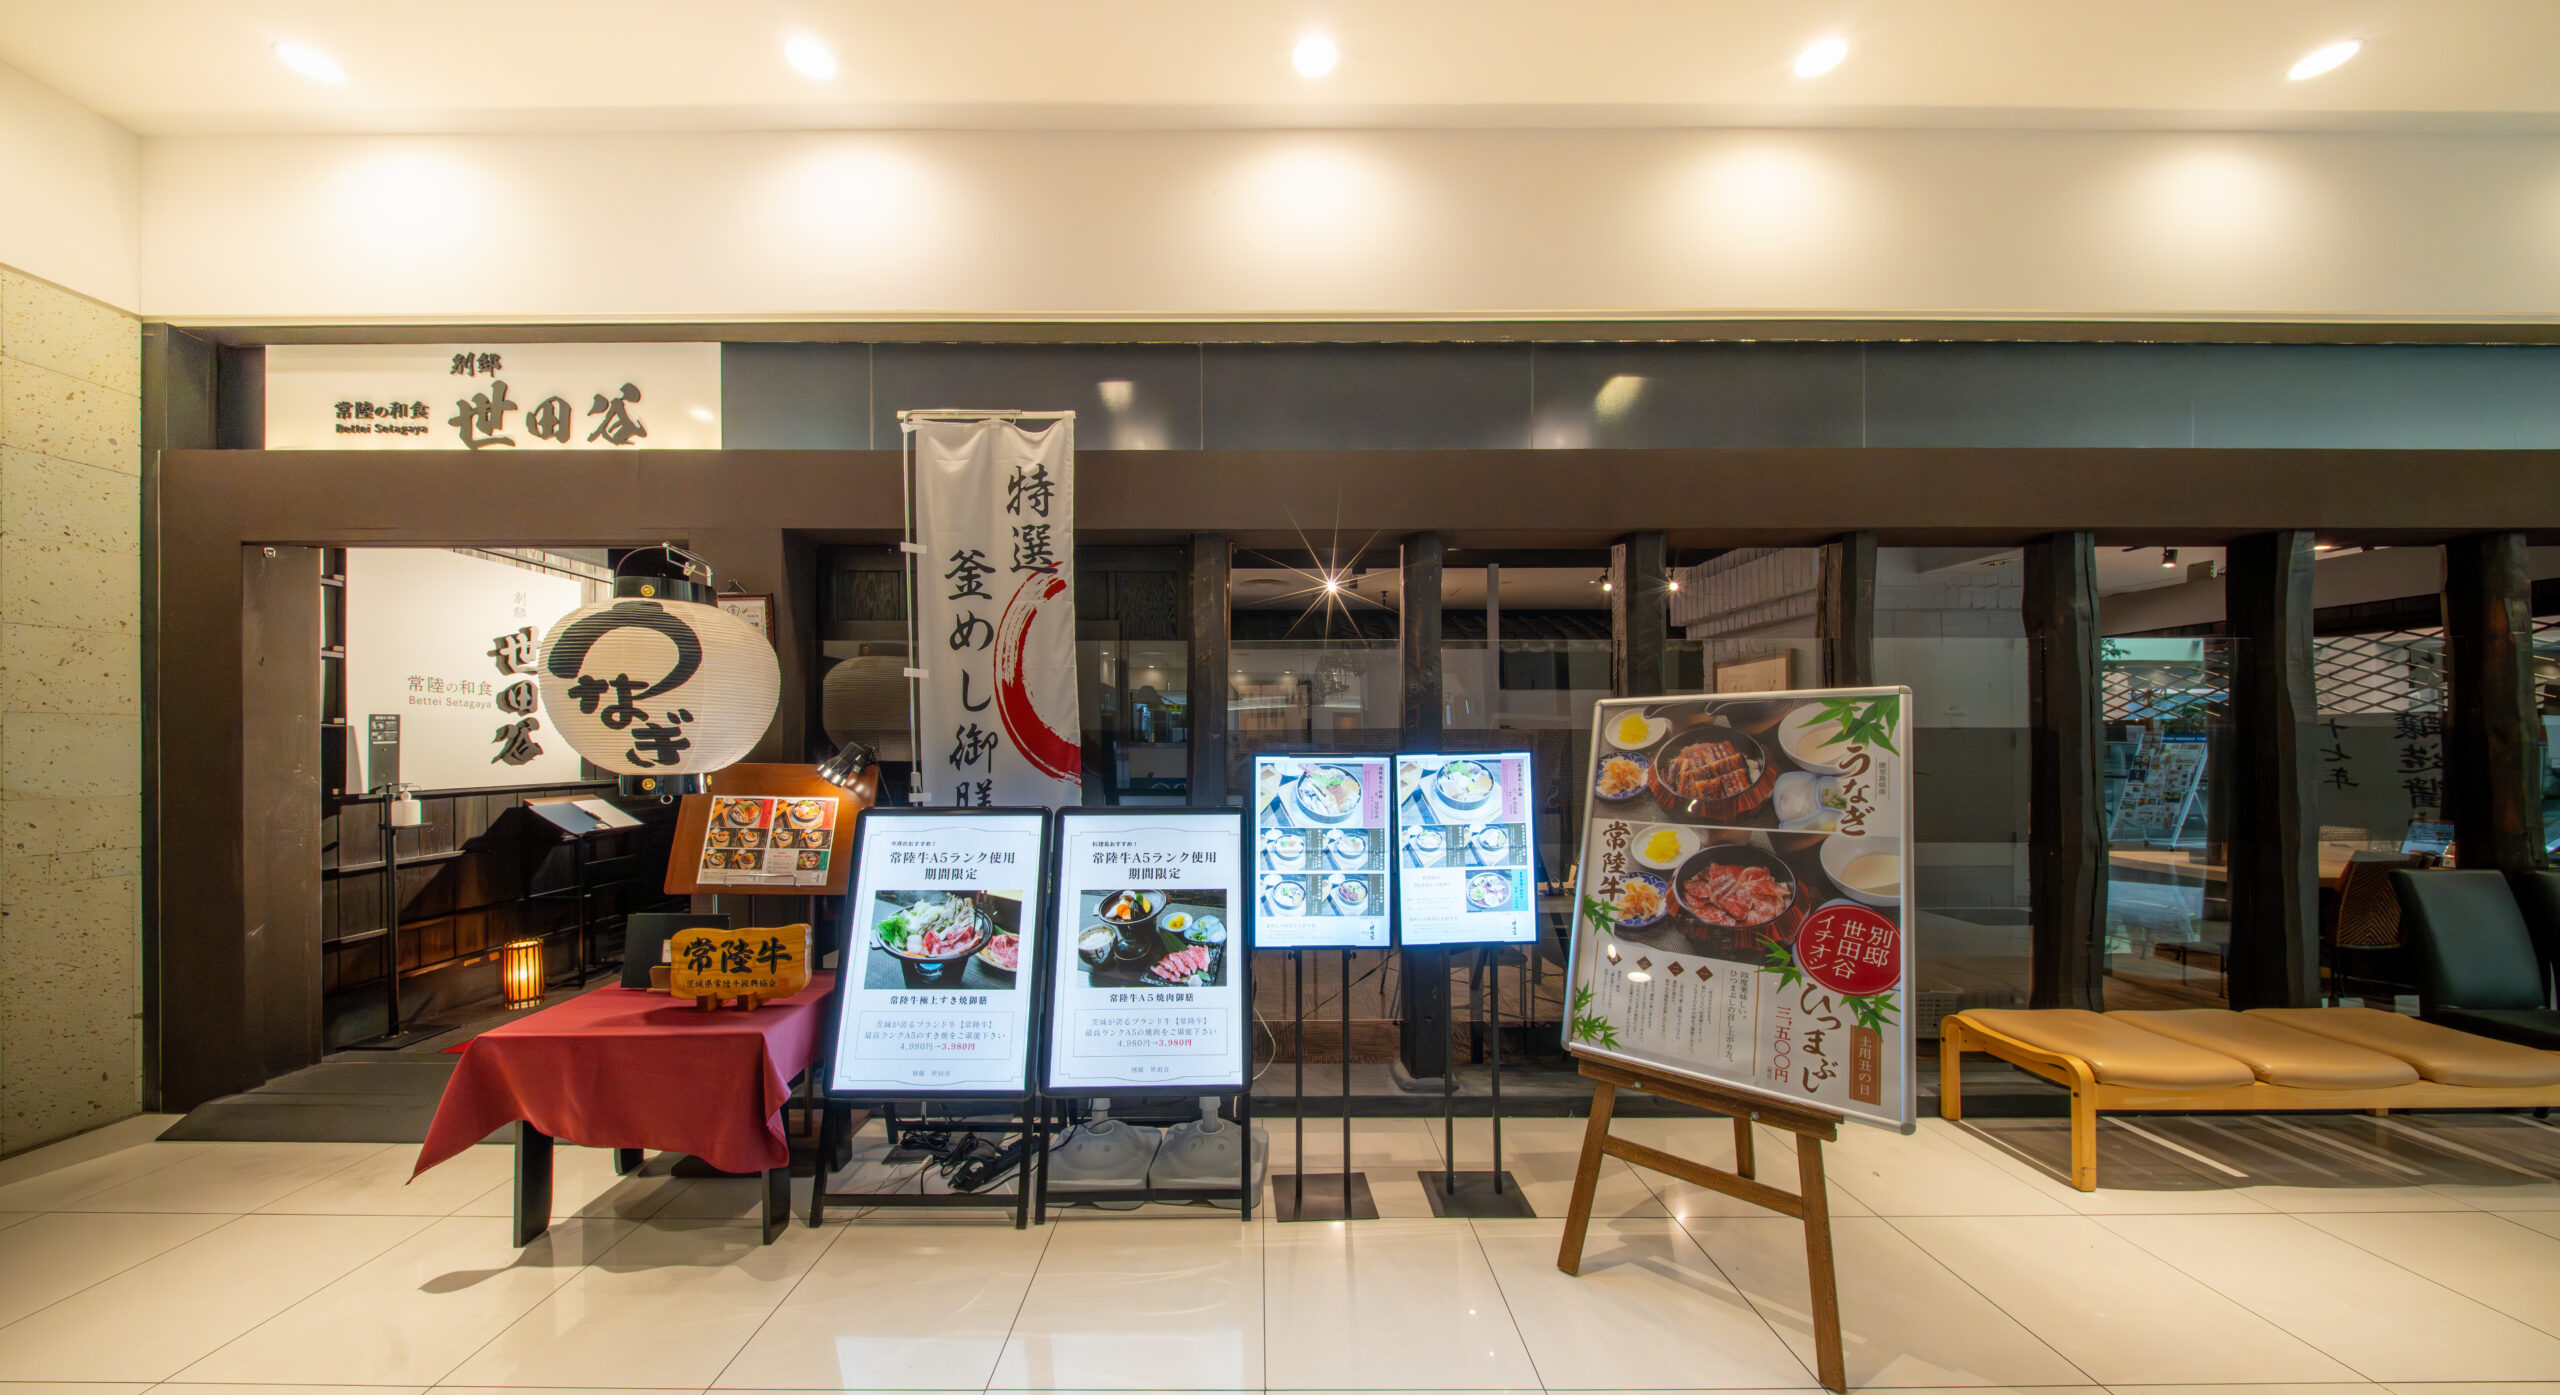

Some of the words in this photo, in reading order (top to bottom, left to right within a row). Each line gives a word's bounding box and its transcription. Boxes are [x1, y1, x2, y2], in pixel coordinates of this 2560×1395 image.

[450, 352, 502, 377] 別邸
[333, 401, 430, 420] 常陸の和食
[335, 423, 372, 433] Bettei
[374, 423, 429, 436] Setagaya
[447, 380, 648, 450] 世田谷
[1005, 463, 1058, 574] 特選
[407, 674, 493, 697] 常陸の和食
[408, 695, 442, 706] Bettei
[445, 697, 492, 710] Setagaya
[487, 625, 544, 766] 世田谷
[546, 600, 704, 769] うなぎ
[1838, 745, 1876, 837] うなぎ
[889, 851, 1016, 865] 常陸牛A5ランク使用
[924, 867, 978, 881] 期間限定
[1092, 851, 1217, 864] 常陸牛A5ランク使用
[1128, 867, 1182, 880] 期間限定
[1597, 820, 1631, 902] 常陸牛
[683, 936, 793, 976] 常陸牛
[1808, 914, 1837, 971] イチオシ
[1831, 919, 1868, 980] 世田谷
[1862, 925, 1894, 968] 別邸
[889, 995, 988, 1006] 常陸牛極上すき焼御膳
[1800, 982, 1842, 1094] ひつまぶし
[1858, 1036, 1873, 1096] 土用丑の日
